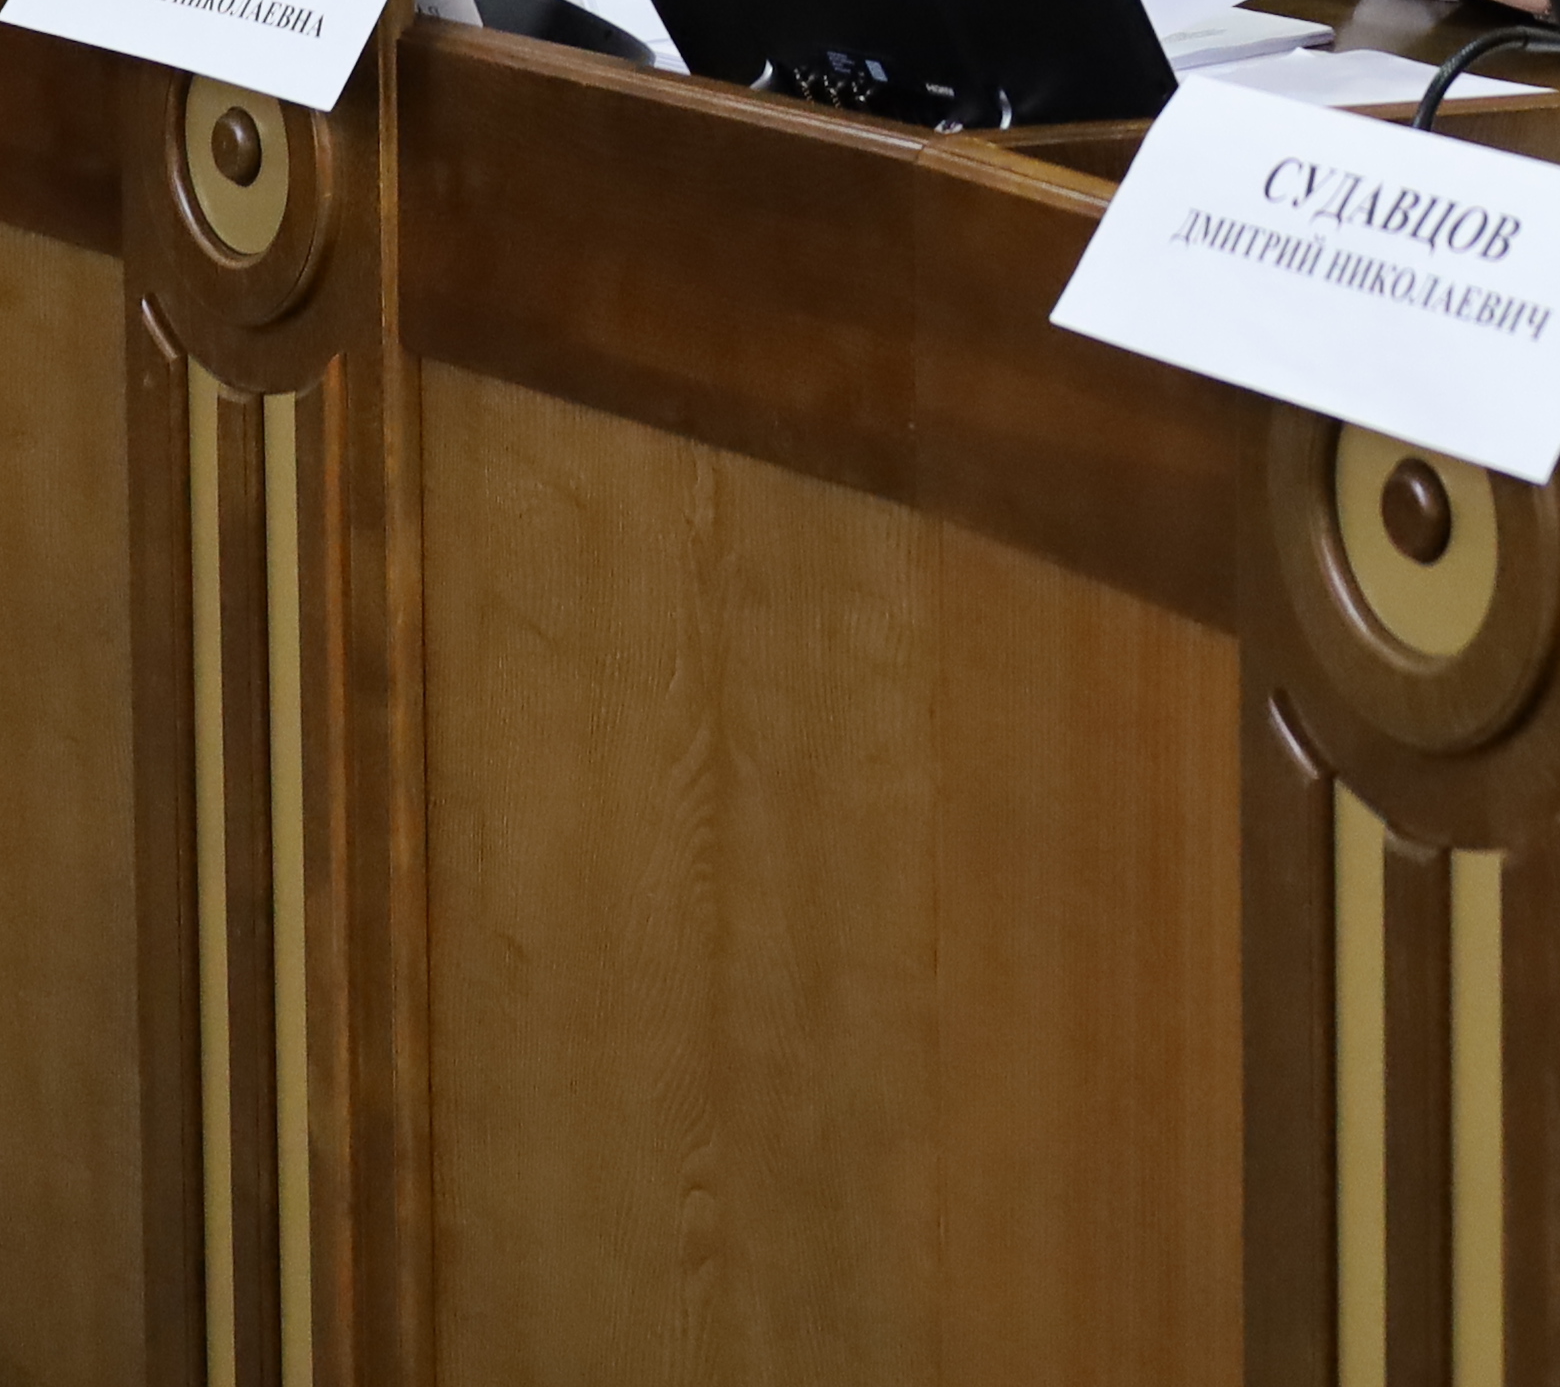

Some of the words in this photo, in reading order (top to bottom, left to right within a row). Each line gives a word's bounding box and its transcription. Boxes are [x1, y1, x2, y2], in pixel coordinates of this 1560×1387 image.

[1263, 156, 1522, 263] СУДАВЦОВ
[1171, 209, 1324, 276] ДМИТРИЙ
[1324, 249, 1552, 340] НИКОЛАЕВИЧ
